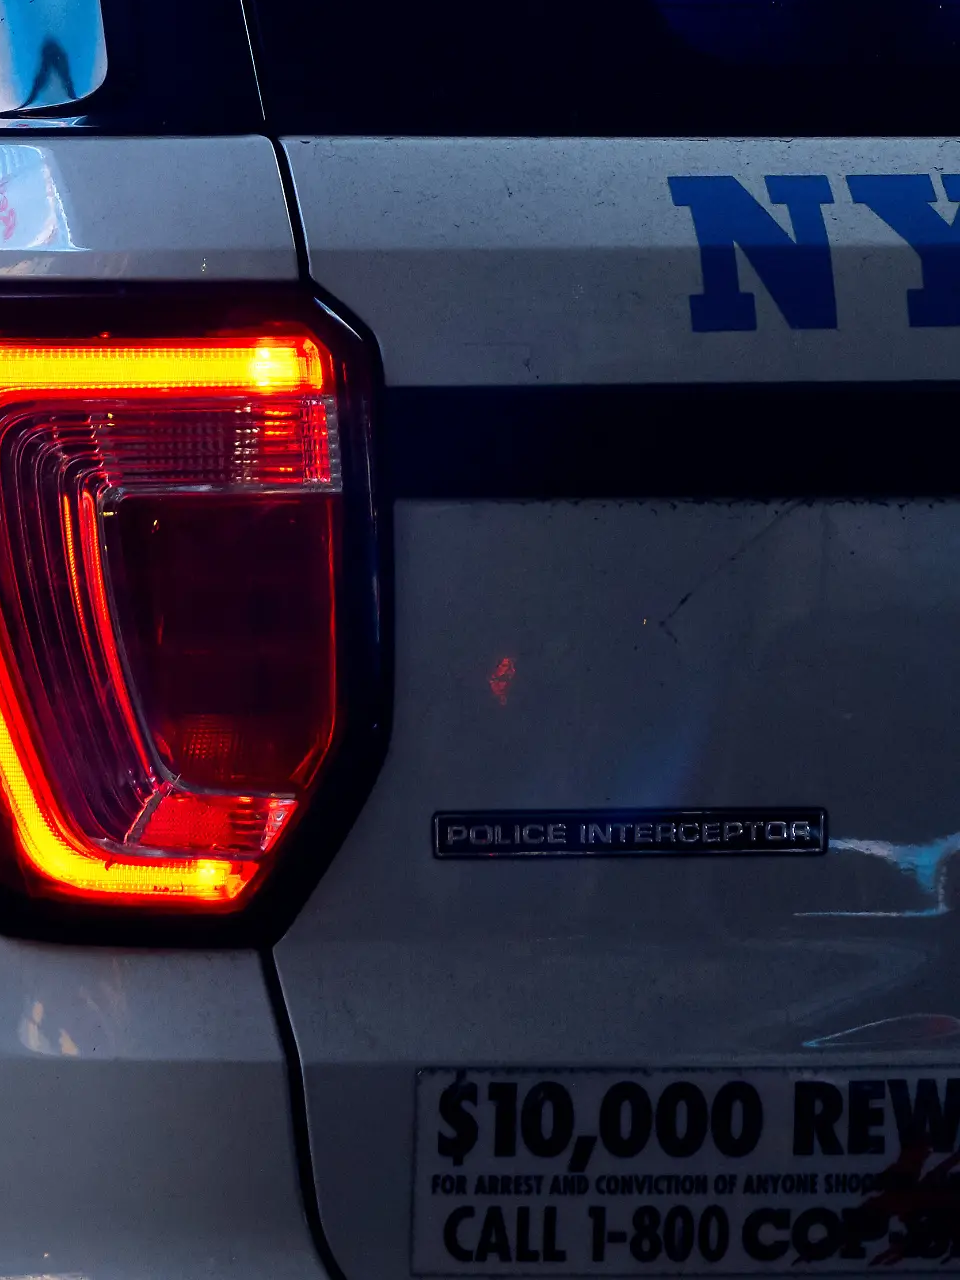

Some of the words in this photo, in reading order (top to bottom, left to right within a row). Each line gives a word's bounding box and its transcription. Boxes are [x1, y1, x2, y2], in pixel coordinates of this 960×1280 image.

[667, 173, 960, 333] NY
[445, 822, 567, 845] POLICE
[580, 820, 811, 844] INTERCEPTOR
[437, 1070, 763, 1172] $10,000
[793, 1077, 960, 1156] REW
[431, 1174, 467, 1195] FOR
[474, 1174, 544, 1195] ARREST
[549, 1174, 589, 1195] AND
[595, 1173, 708, 1196] CONVICTION
[714, 1173, 738, 1195] OF
[743, 1173, 818, 1195] ANYONE
[444, 1205, 567, 1263] CALL
[588, 1204, 730, 1263] 1-800
